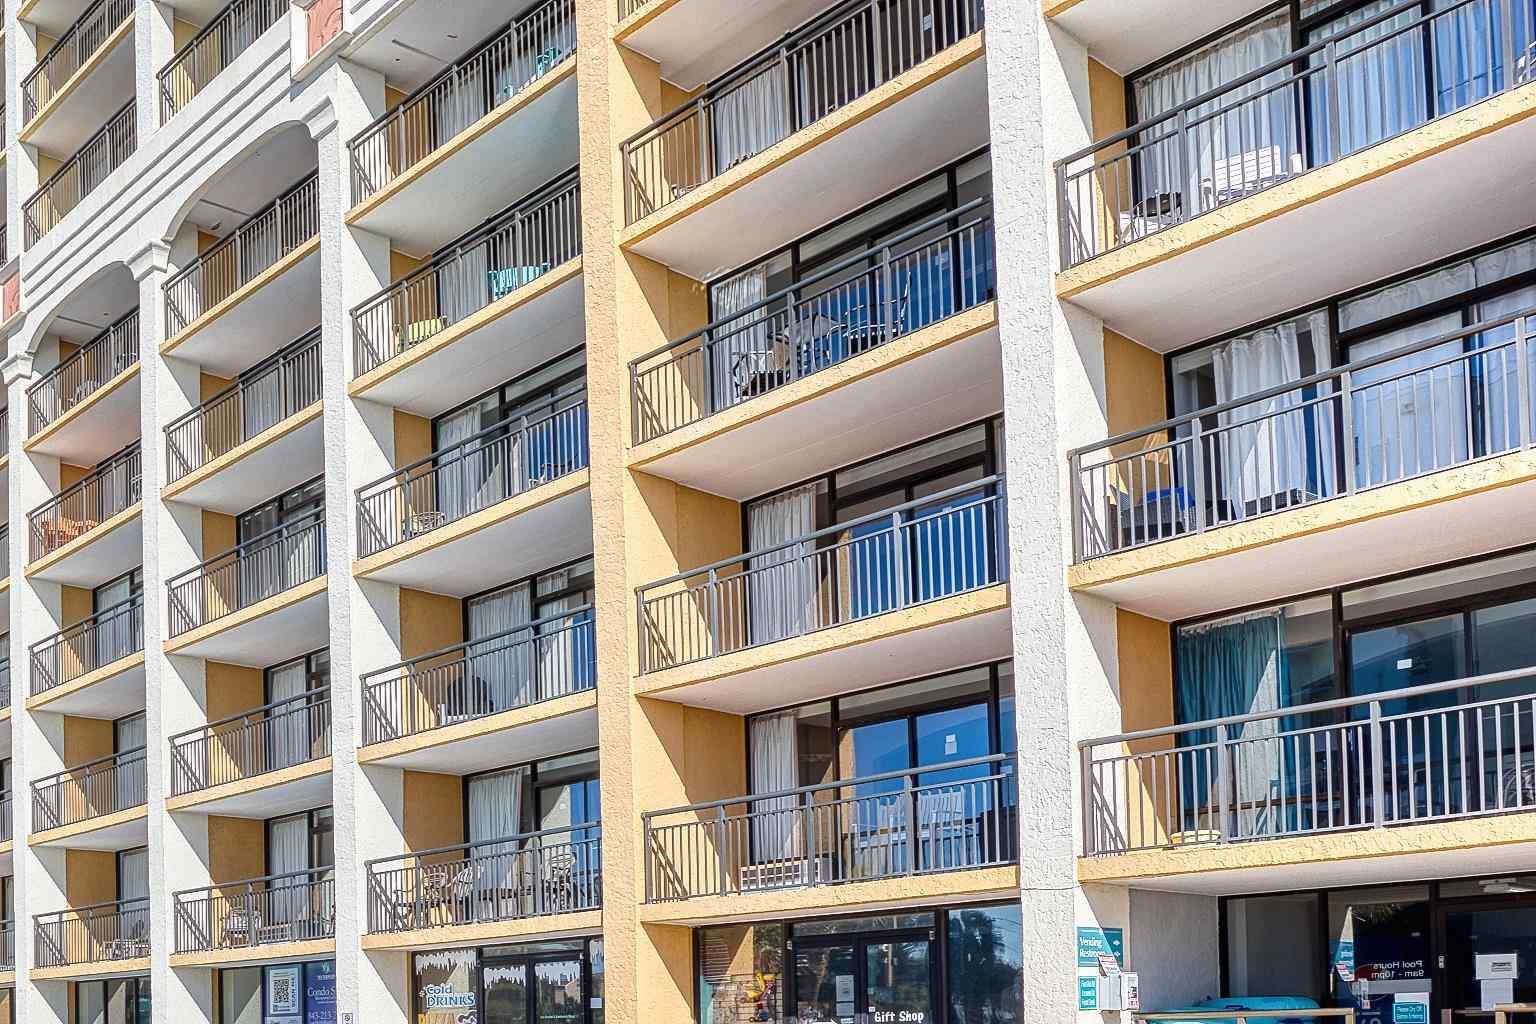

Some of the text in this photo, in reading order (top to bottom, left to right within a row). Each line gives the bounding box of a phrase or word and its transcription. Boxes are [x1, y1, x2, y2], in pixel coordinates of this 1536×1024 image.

[1079, 935, 1103, 949] Vending
[427, 993, 476, 1008] DRINKS
[874, 1010, 924, 1024] Gift Shop
